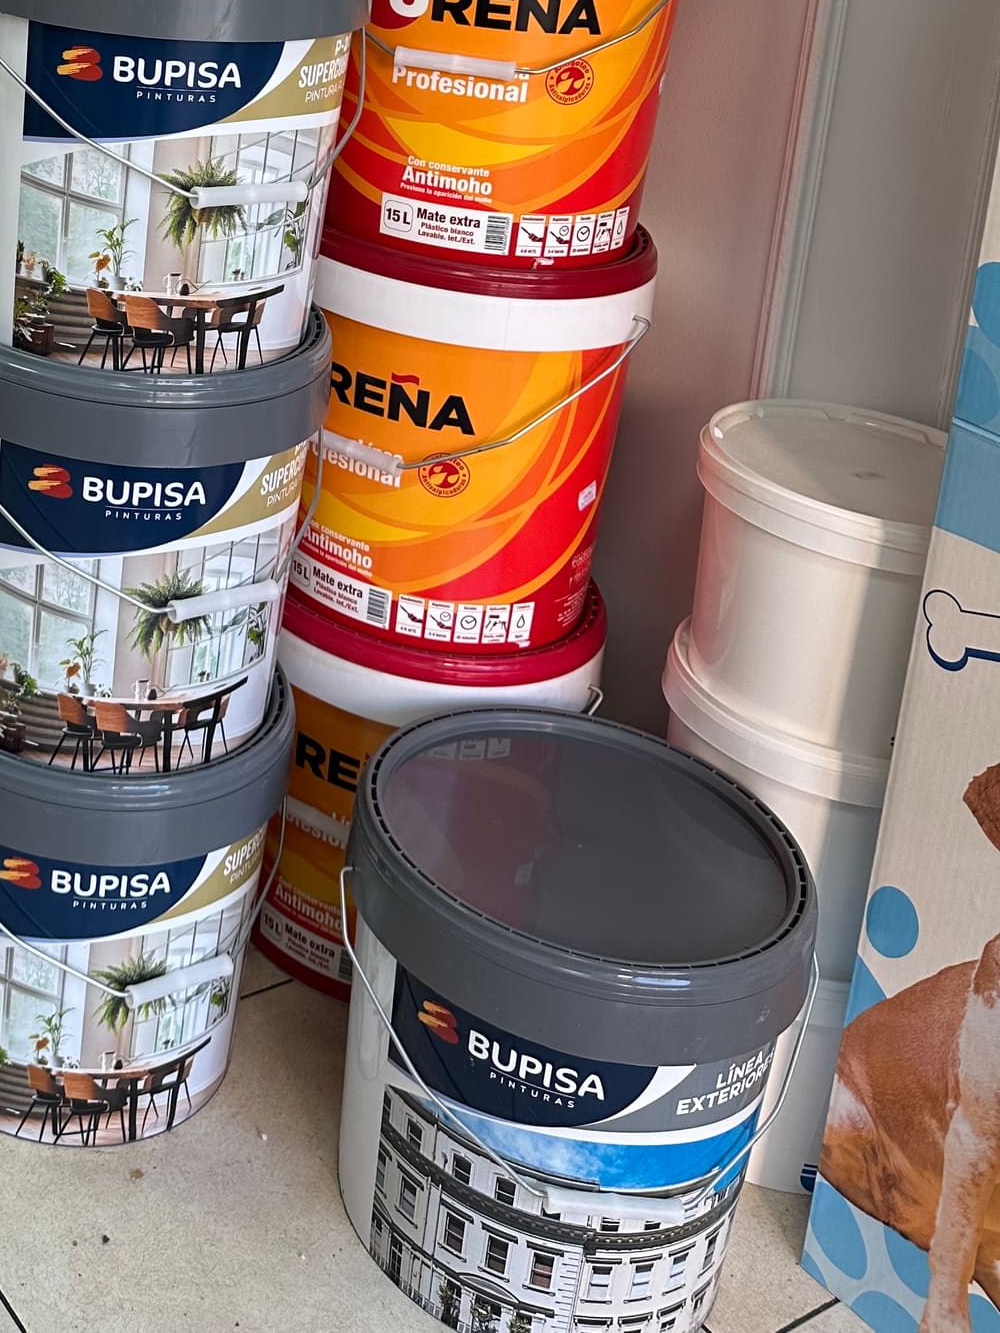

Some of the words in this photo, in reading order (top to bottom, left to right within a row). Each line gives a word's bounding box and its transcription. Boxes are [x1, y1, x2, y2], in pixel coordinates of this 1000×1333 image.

[113, 55, 241, 89] BUPISA
[392, 66, 529, 103] Profesional
[136, 90, 216, 103] PINTURAS
[402, 165, 493, 195] Antimoho
[408, 155, 426, 168] Con
[428, 161, 490, 178] conservante
[386, 207, 400, 222] 15
[403, 211, 411, 225] L
[417, 207, 446, 223] Mate
[450, 215, 481, 228] extra
[421, 222, 448, 233] Plástico
[450, 226, 474, 237] blanco
[330, 362, 475, 435] REÑA
[82, 476, 206, 508] BUPISA
[105, 510, 182, 521] PINTURAS
[304, 526, 373, 569] Antimoho
[321, 524, 370, 552] conservante
[313, 566, 335, 587] Mate
[337, 581, 363, 599] extra
[50, 869, 171, 898] BUPISA
[73, 900, 147, 910] PINTURAS
[285, 923, 307, 944] Mate
[310, 938, 335, 958] extra
[467, 1028, 606, 1101] BUPISA
[716, 1050, 763, 1090] LÍNEA
[490, 1072, 575, 1108] PINTURAS
